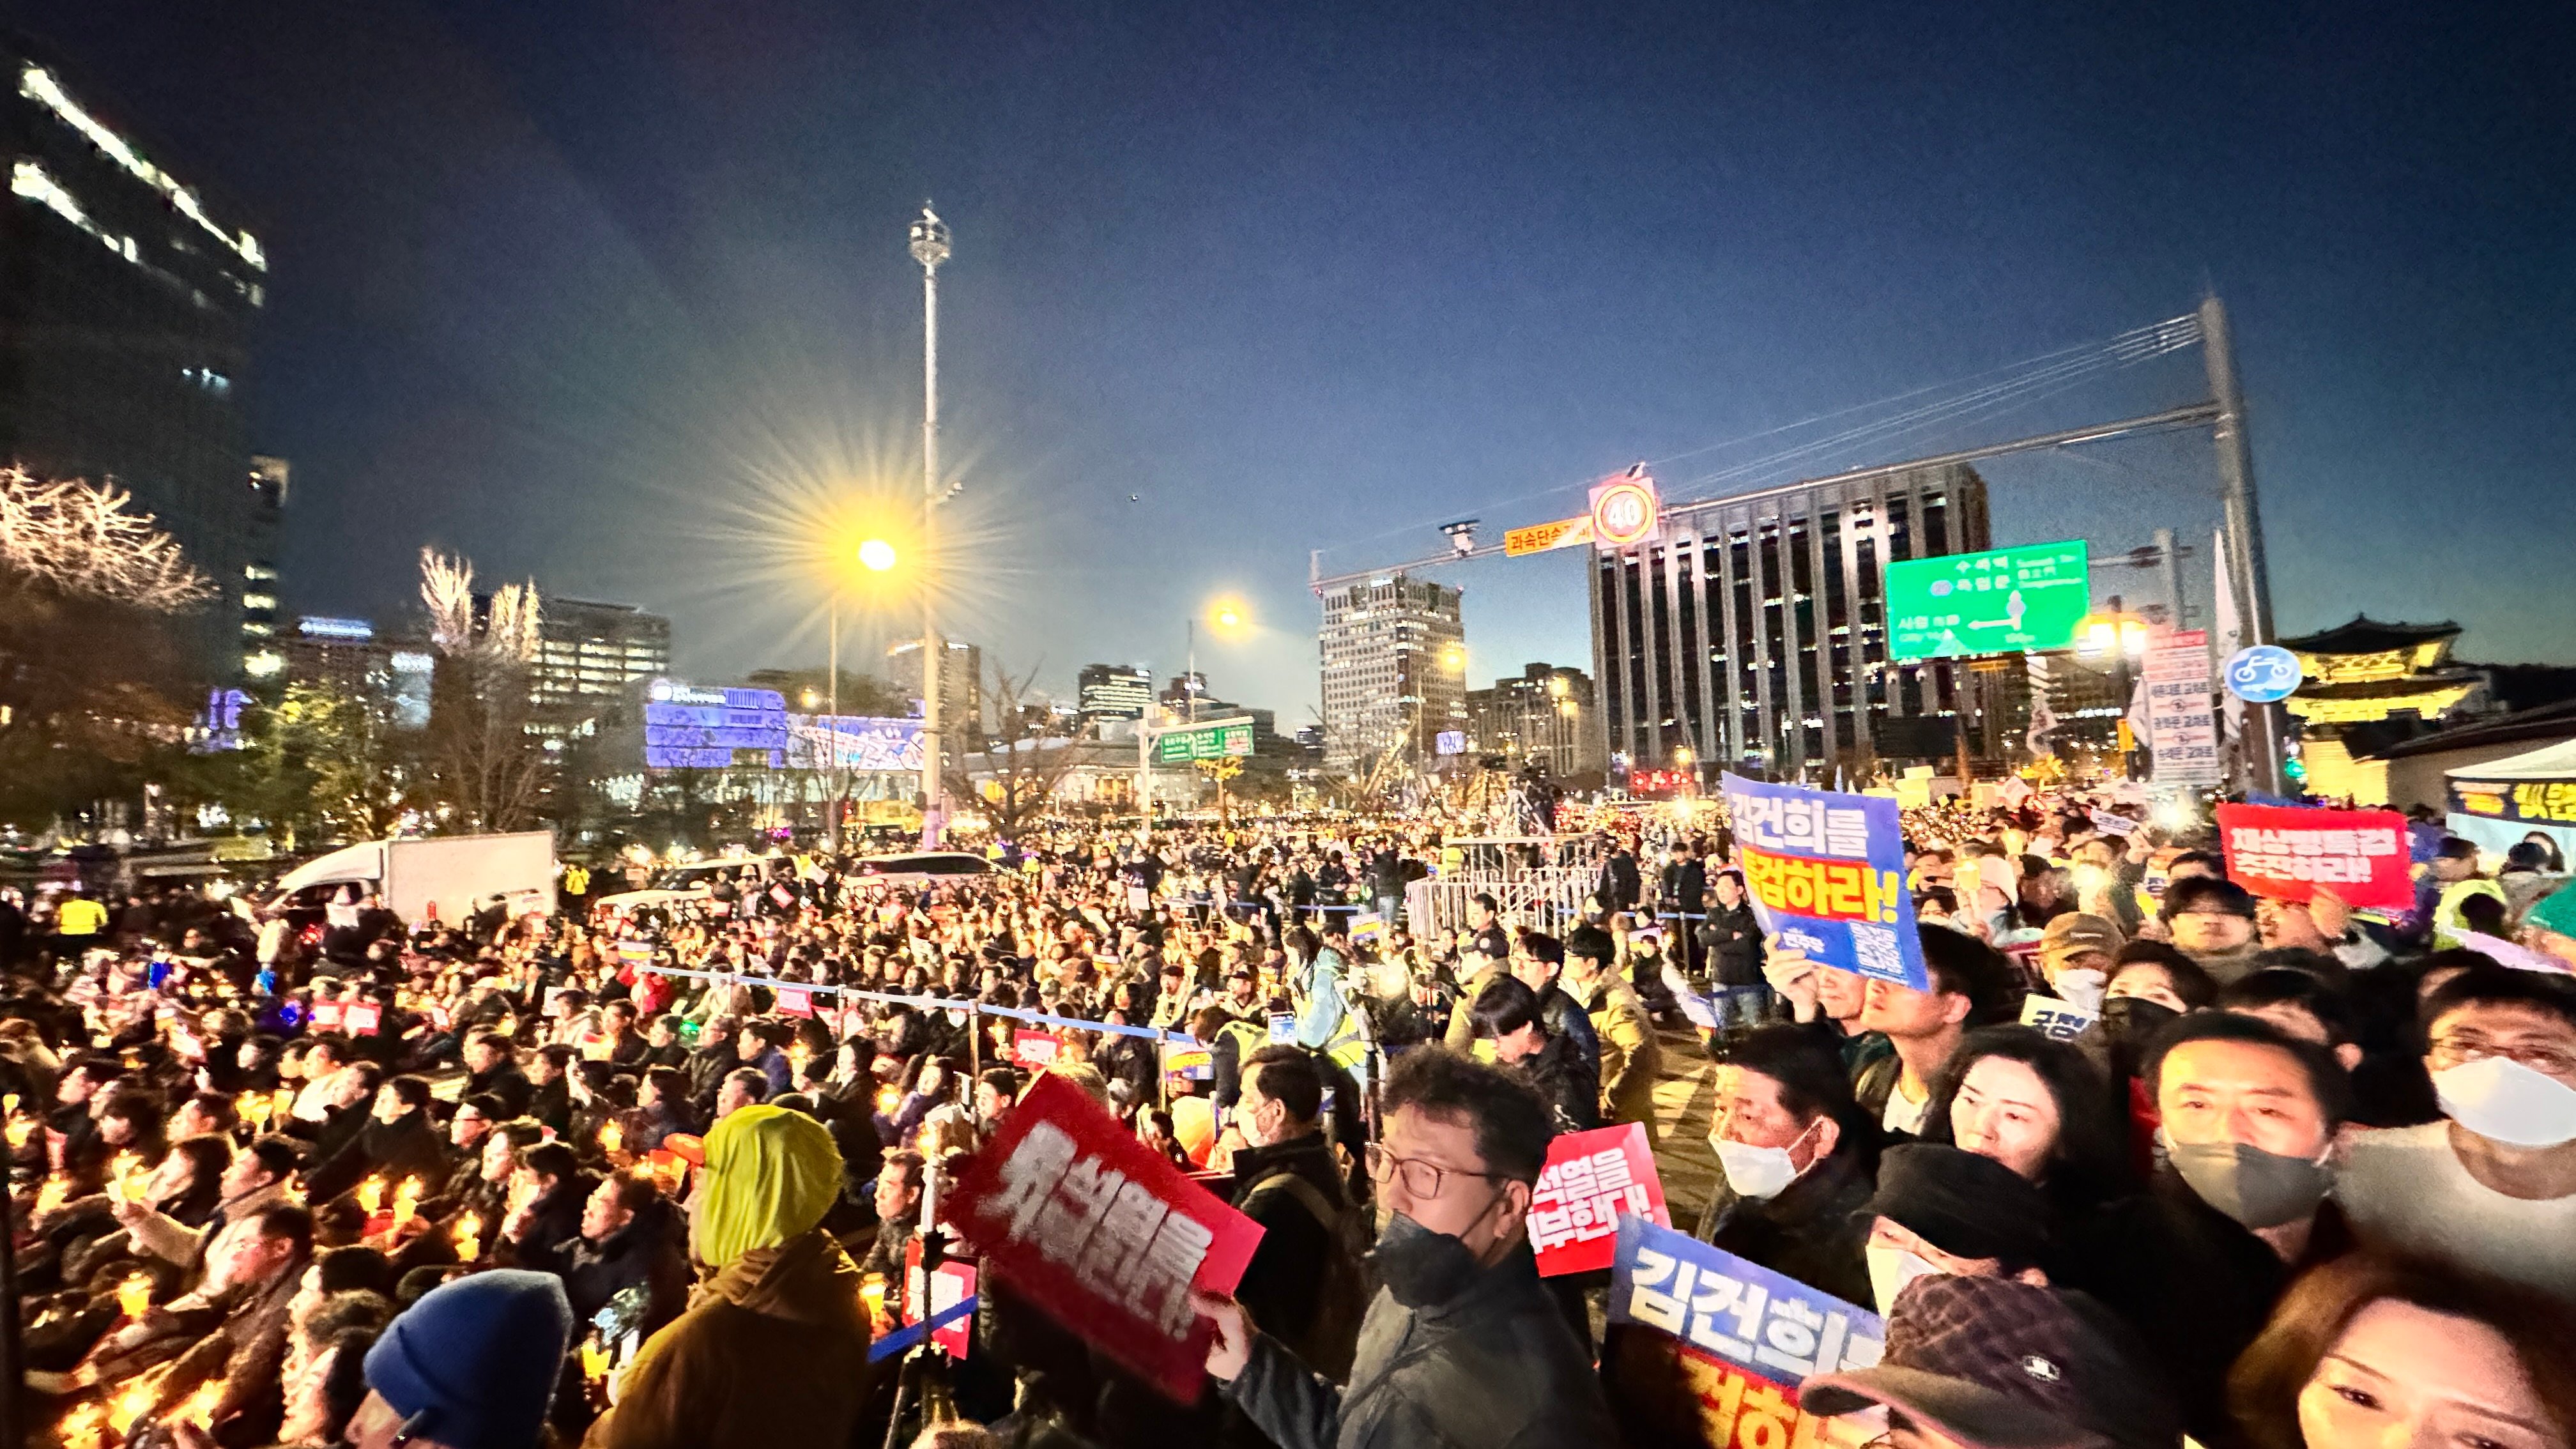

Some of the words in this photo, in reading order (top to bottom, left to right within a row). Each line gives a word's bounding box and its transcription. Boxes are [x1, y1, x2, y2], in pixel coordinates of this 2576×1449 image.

[1607, 498, 1643, 528] 40
[1731, 793, 1869, 857] 김건희를
[1742, 847, 1899, 923] 특검하라!
[1533, 1147, 1633, 1205] 석열을
